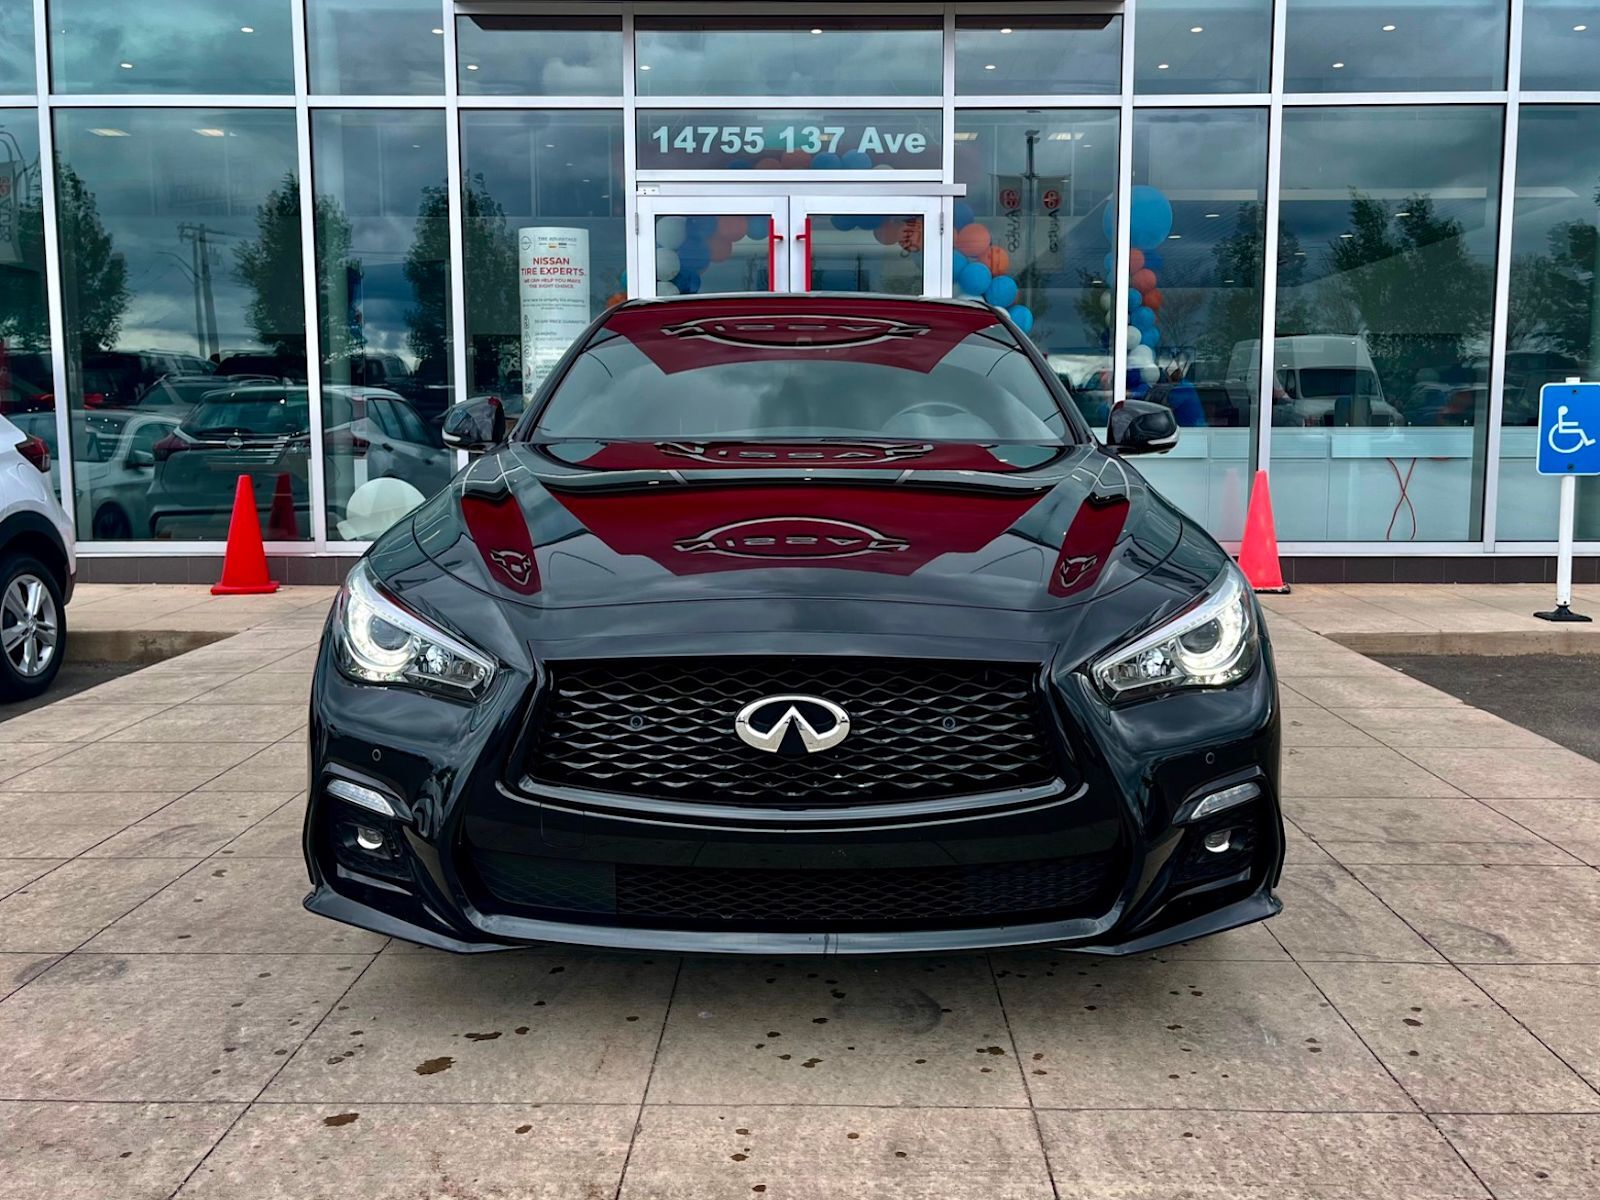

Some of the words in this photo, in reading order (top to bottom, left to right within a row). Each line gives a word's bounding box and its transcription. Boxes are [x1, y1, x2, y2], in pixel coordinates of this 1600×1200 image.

[652, 126, 765, 154] 14755
[779, 126, 845, 154] 137
[857, 126, 926, 154] Ave
[533, 257, 570, 265] NISSAN
[521, 267, 537, 276] TIRE
